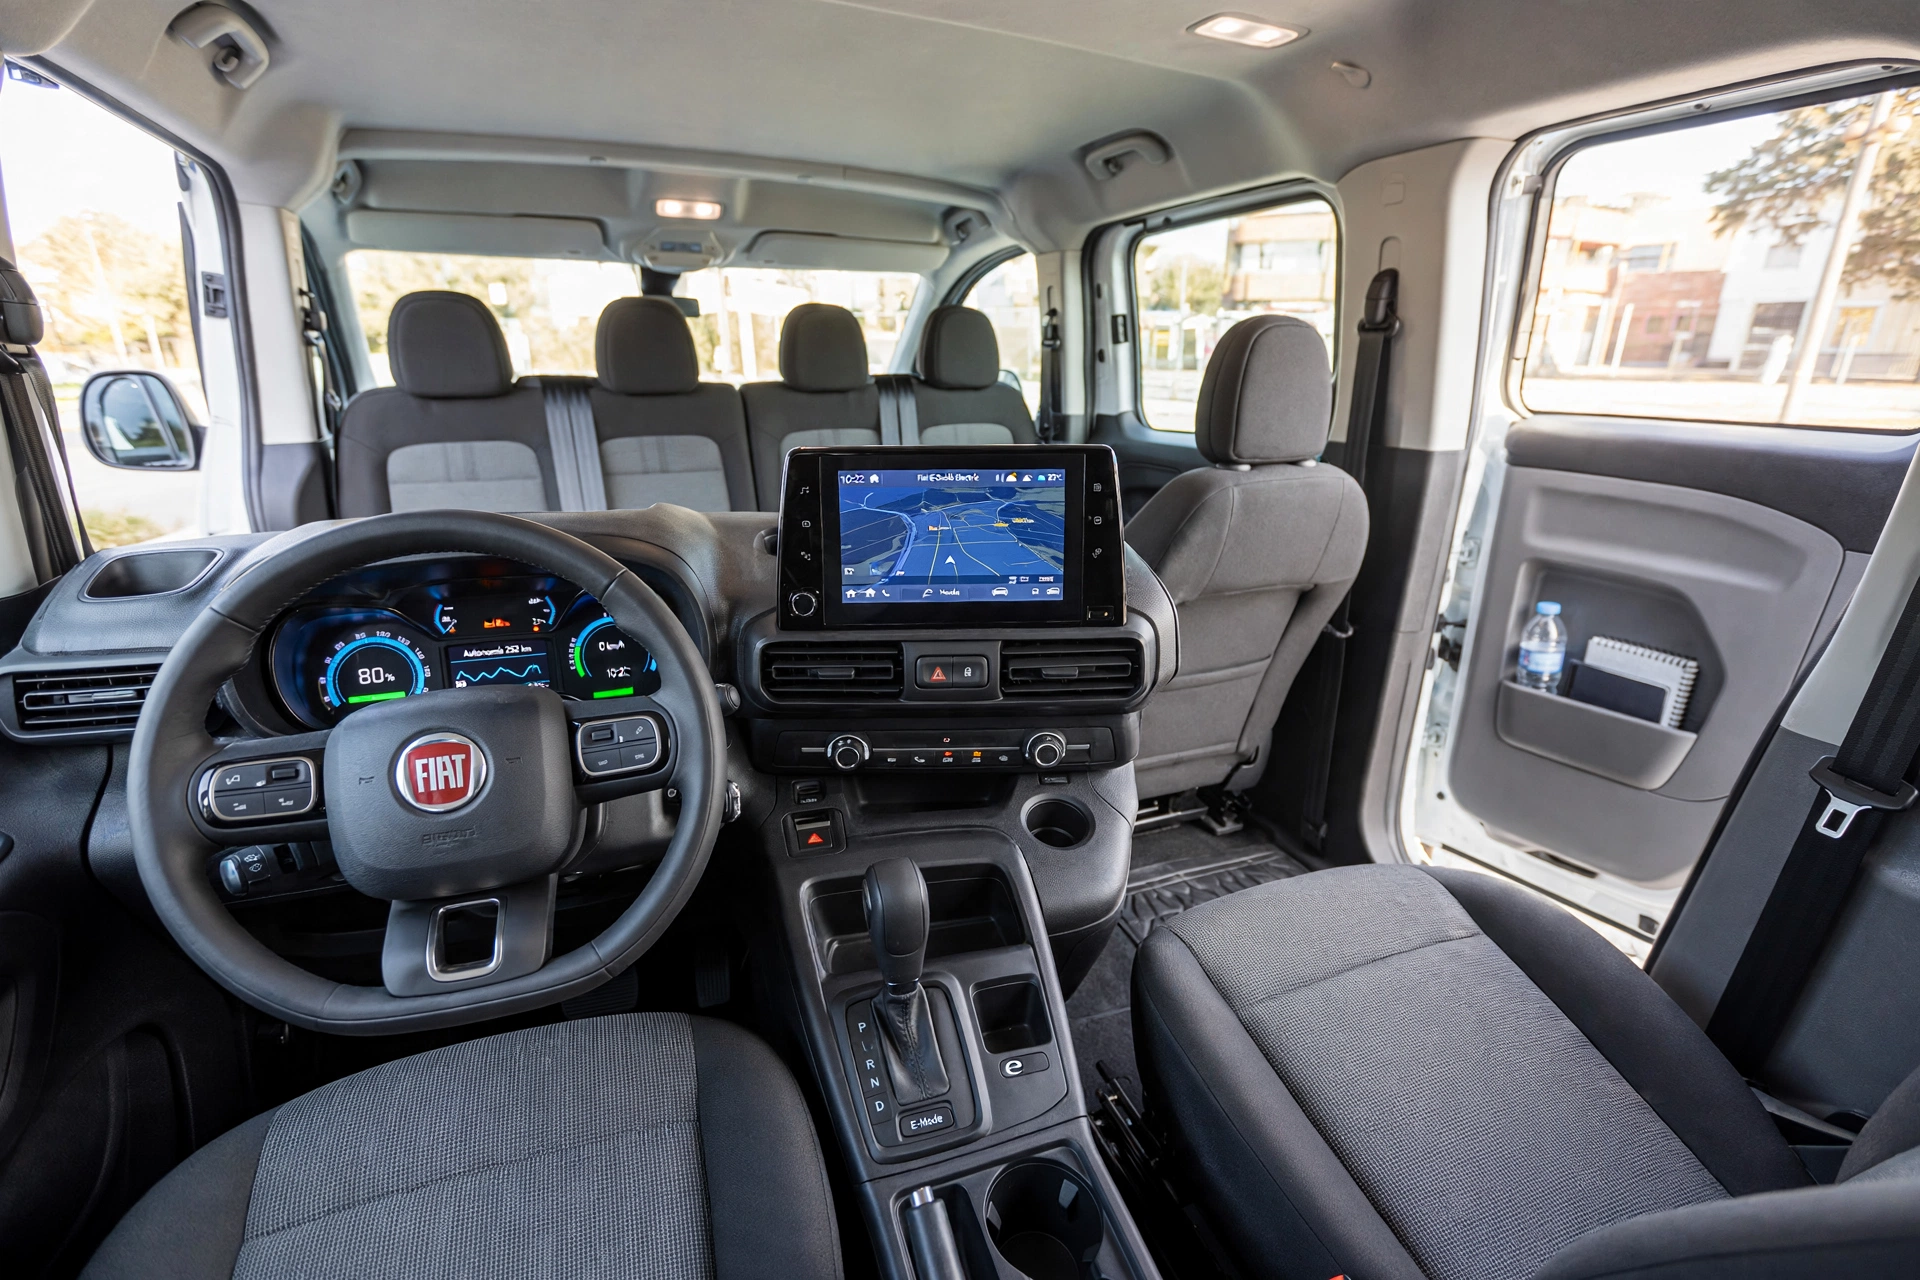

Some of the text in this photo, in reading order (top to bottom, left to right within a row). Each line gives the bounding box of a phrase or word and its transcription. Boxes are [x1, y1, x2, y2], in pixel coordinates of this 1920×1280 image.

[415, 753, 466, 793] FIAT
[858, 1022, 866, 1032] P
[865, 1059, 875, 1070] R
[870, 1076, 880, 1088] N
[875, 1100, 885, 1112] D
[910, 1113, 943, 1130] E-Mode
